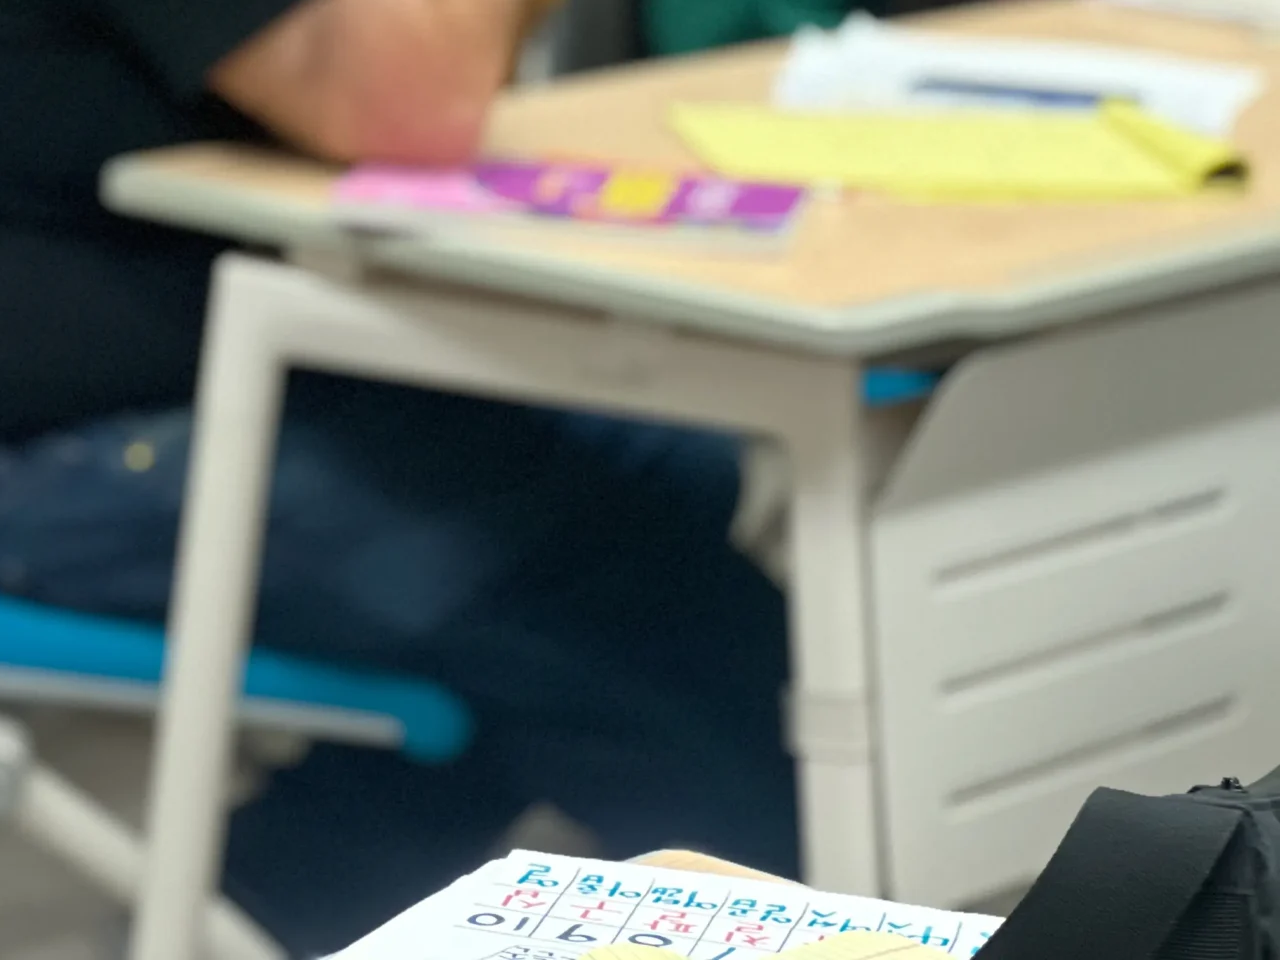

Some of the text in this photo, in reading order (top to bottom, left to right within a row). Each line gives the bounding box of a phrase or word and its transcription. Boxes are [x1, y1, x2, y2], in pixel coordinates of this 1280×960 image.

[517, 863, 559, 888] 열
[576, 874, 641, 898] 아홉
[501, 889, 546, 909] 십
